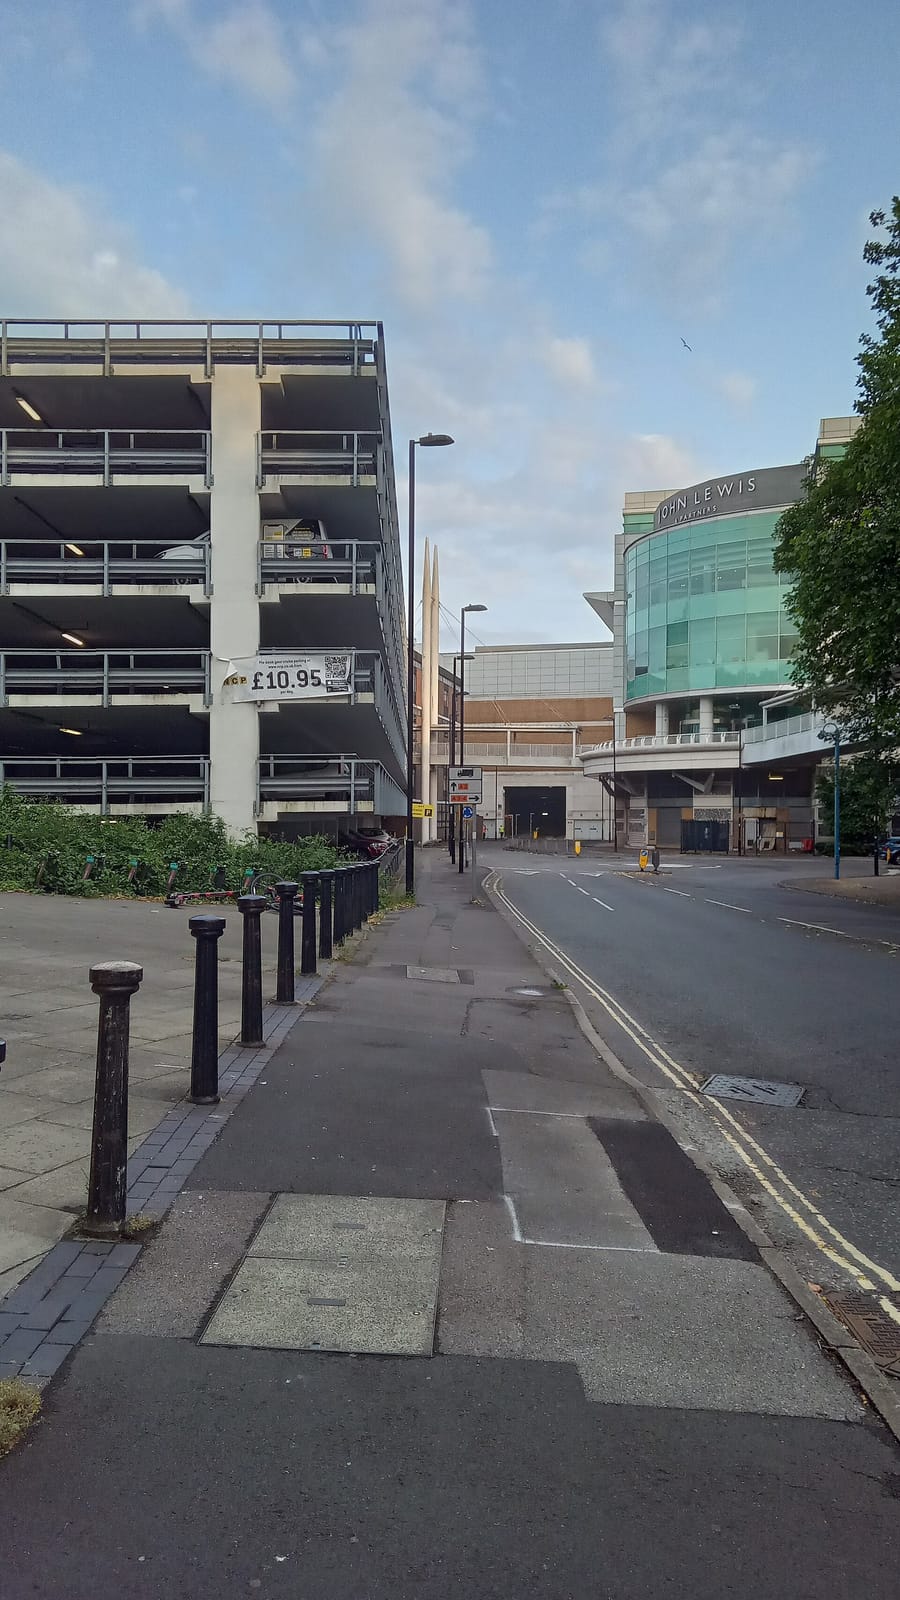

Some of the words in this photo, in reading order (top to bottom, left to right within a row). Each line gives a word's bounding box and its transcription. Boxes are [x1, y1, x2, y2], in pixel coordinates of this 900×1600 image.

[658, 496, 688, 523] JOHN
[694, 478, 756, 504] LEWIS
[679, 505, 717, 521] PARTNERS
[252, 669, 321, 690] £10.95
